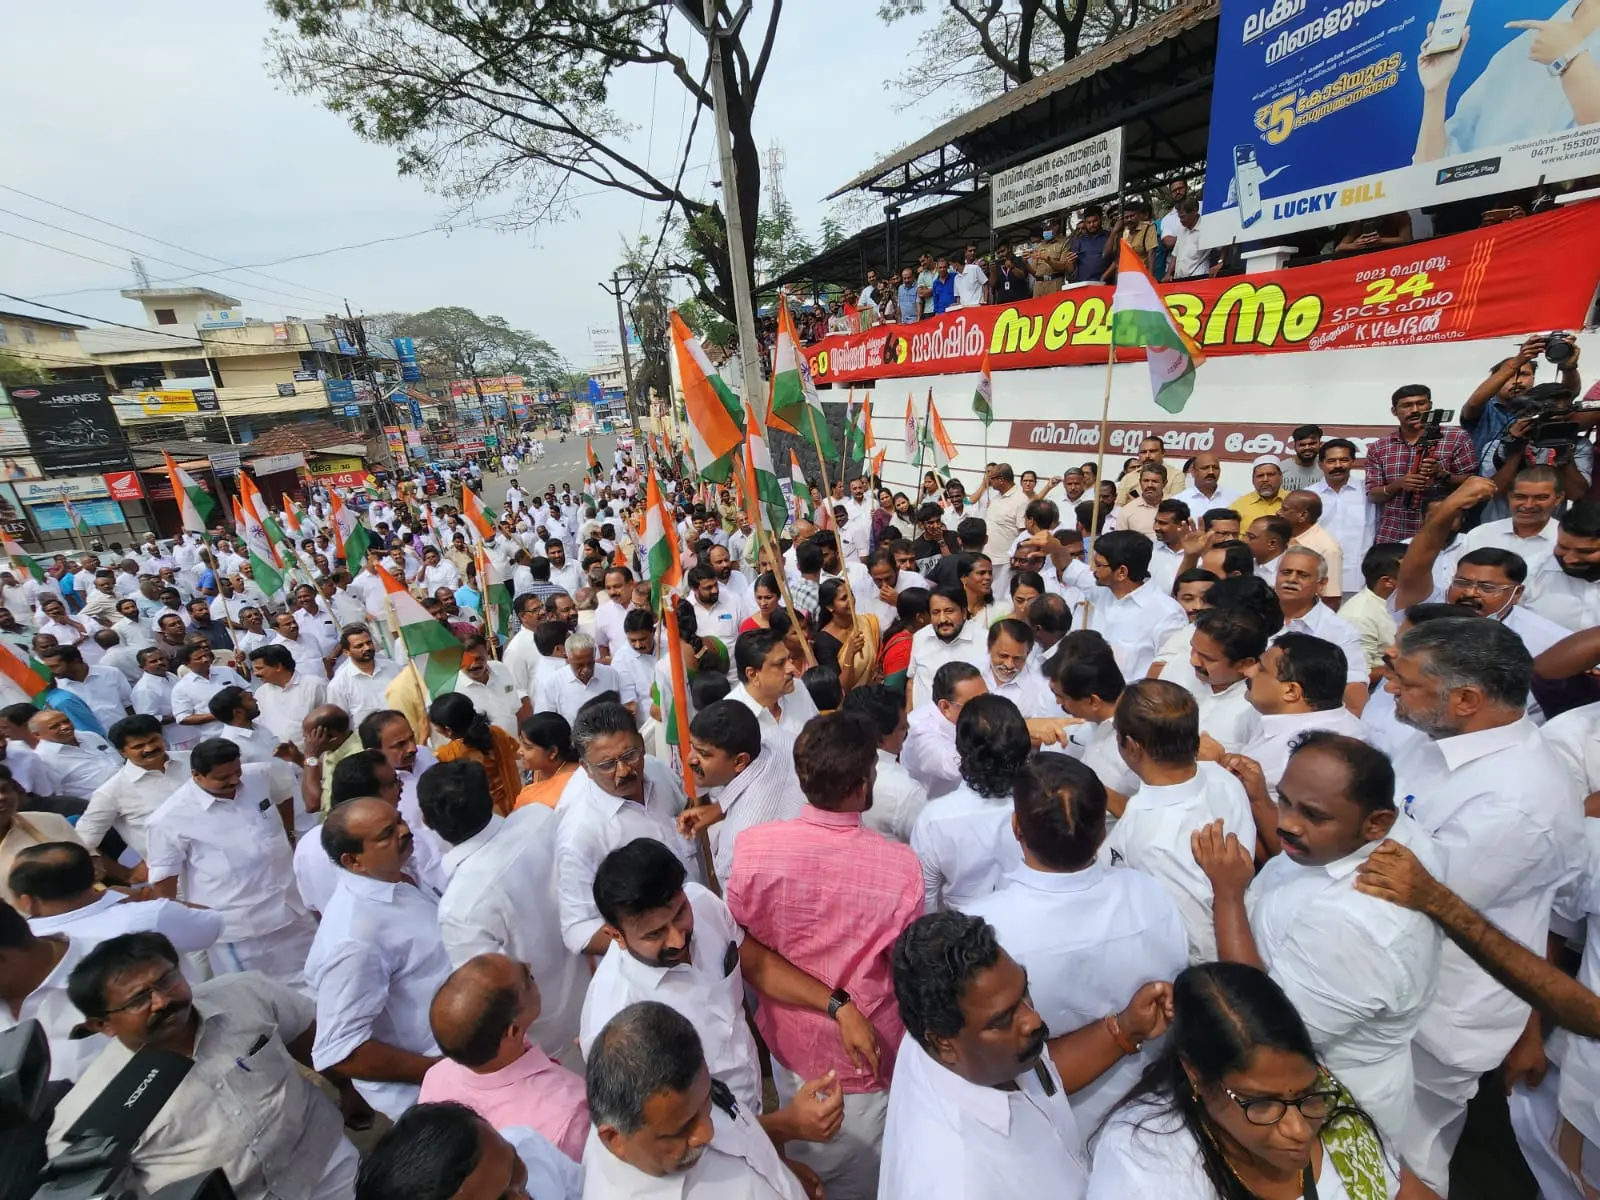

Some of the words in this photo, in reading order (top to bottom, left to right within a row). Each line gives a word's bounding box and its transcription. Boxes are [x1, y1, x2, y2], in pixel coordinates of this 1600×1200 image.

[1454, 168, 1480, 178] Google
[1480, 165, 1497, 174] Play
[1273, 191, 1337, 220] LUCKY
[1340, 180, 1386, 207] BILL
[1356, 268, 1386, 283] 2023
[1363, 272, 1434, 305] 24
[911, 316, 984, 363] വാർഷിക
[51, 393, 101, 404] HIGHNESS
[1030, 422, 1101, 446] സിവിൽ
[338, 474, 353, 484] 4G
[123, 1068, 159, 1108] XDCAM
